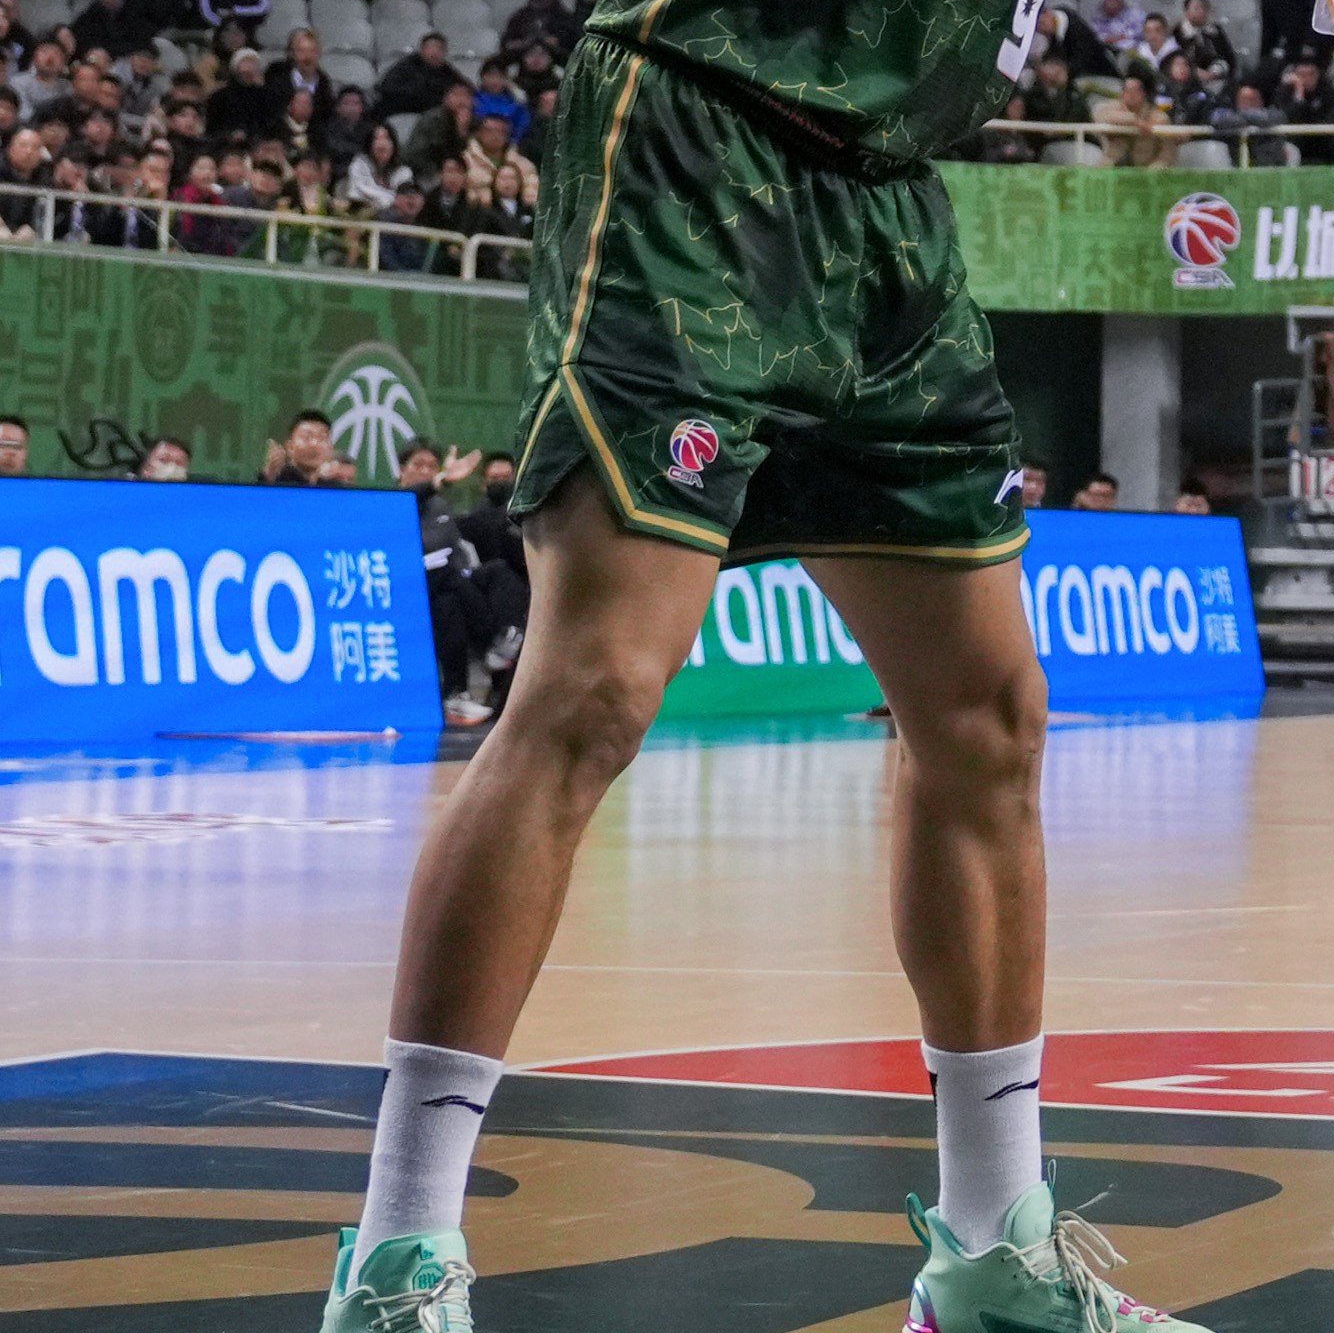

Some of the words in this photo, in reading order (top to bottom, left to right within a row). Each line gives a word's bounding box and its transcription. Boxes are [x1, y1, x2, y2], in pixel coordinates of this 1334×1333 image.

[668, 465, 704, 489] CBA
[324, 549, 392, 609] 沙特
[329, 621, 401, 683] 阿美
